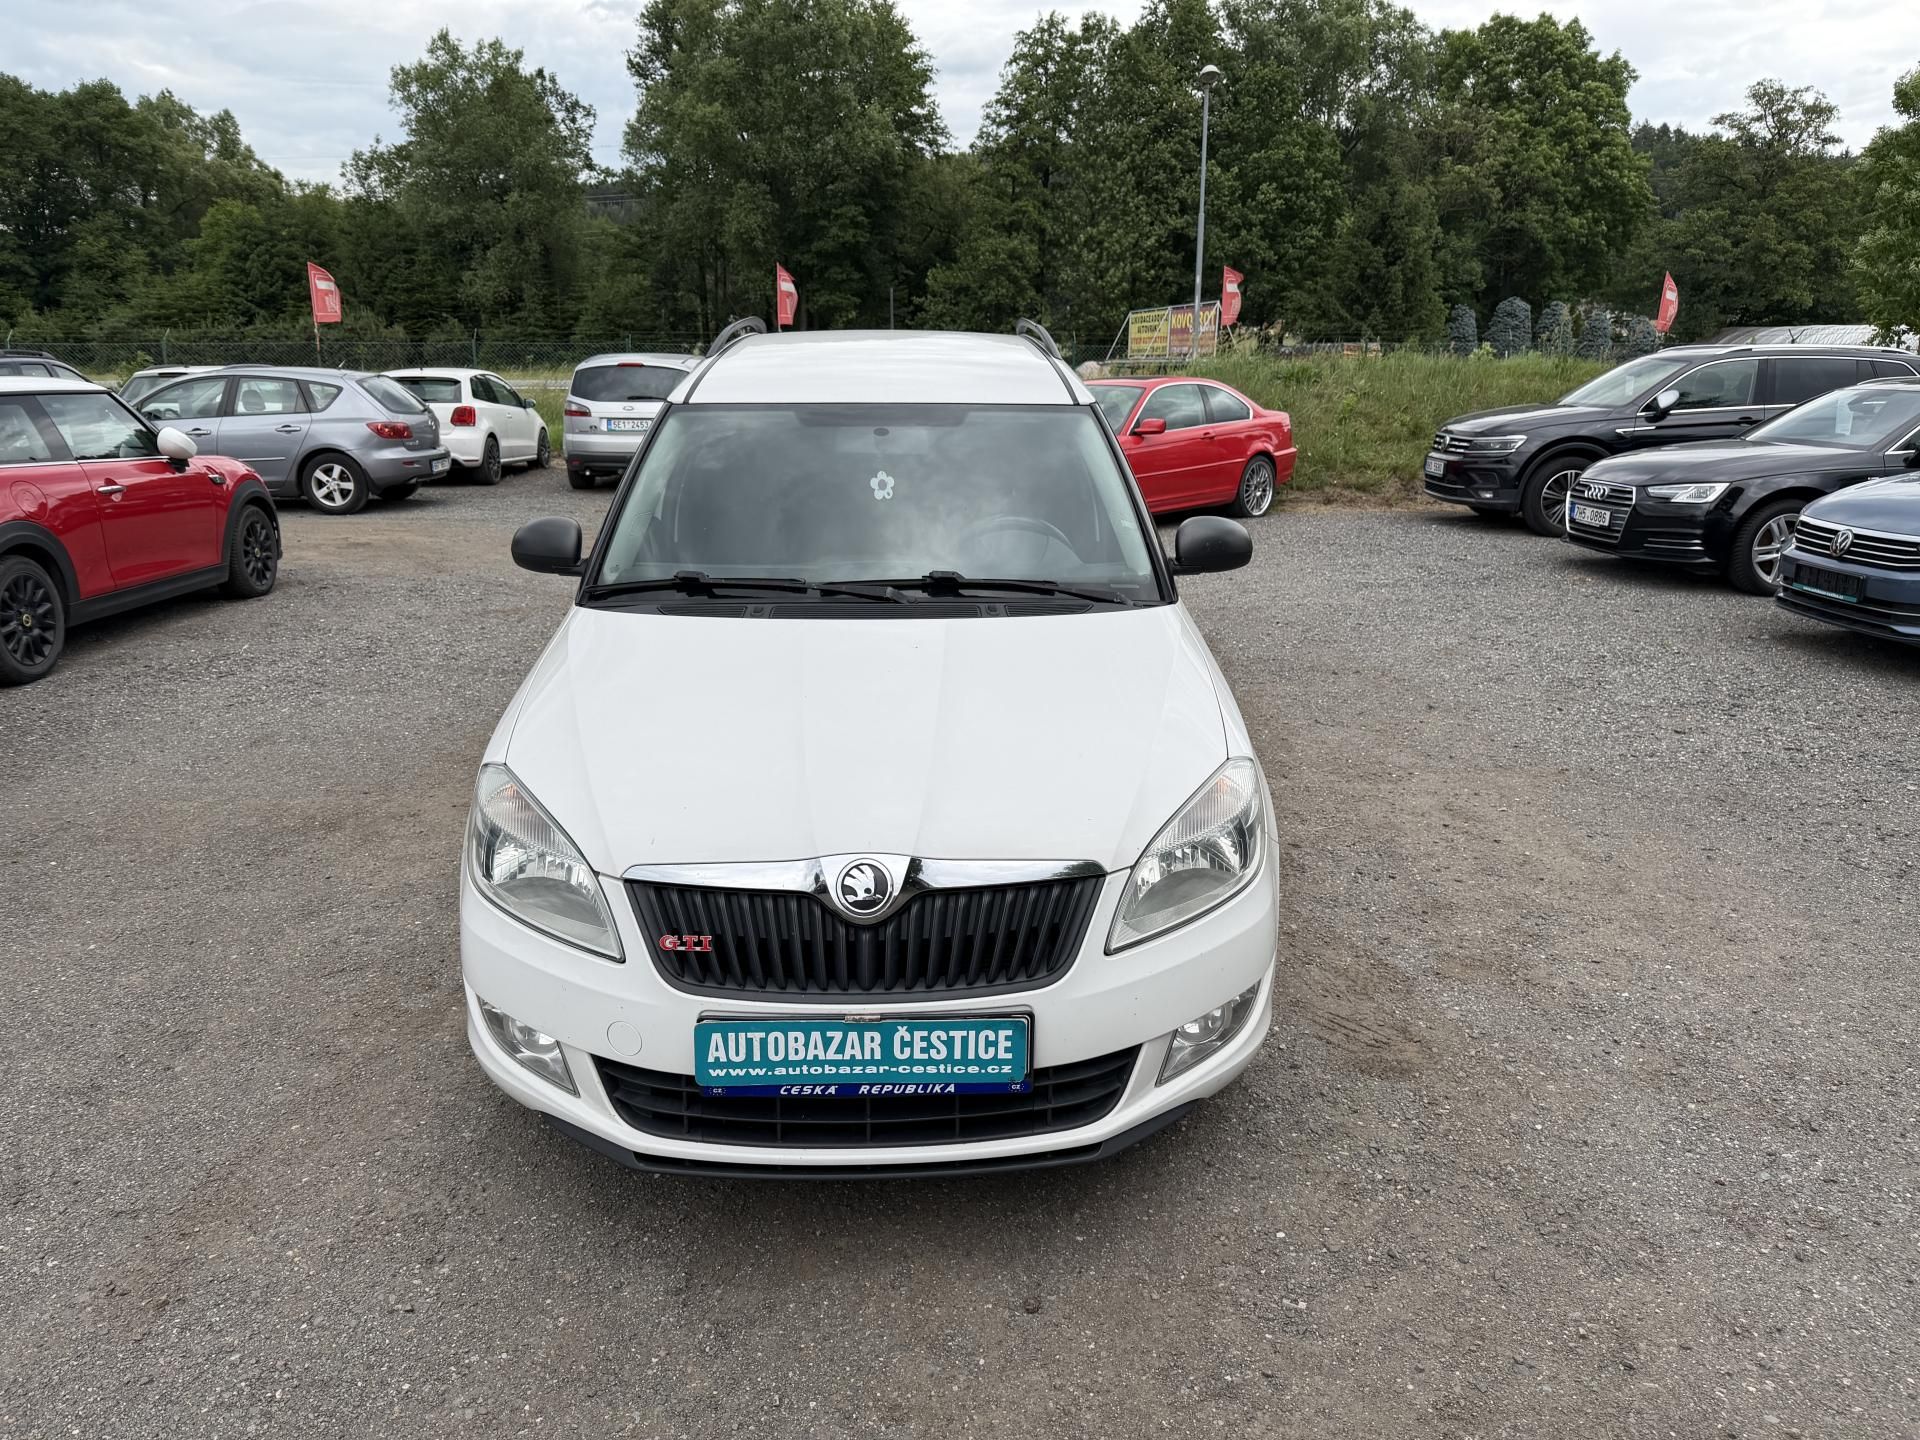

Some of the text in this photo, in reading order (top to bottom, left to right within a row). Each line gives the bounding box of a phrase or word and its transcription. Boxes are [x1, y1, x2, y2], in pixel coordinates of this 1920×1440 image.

[659, 934, 712, 952] GTI
[707, 1025, 1013, 1063] AUTOBAZAR ČESTICE
[708, 1063, 1012, 1077] www.autobazar-cestice.cz
[858, 1083, 956, 1095] REPUBLIKA
